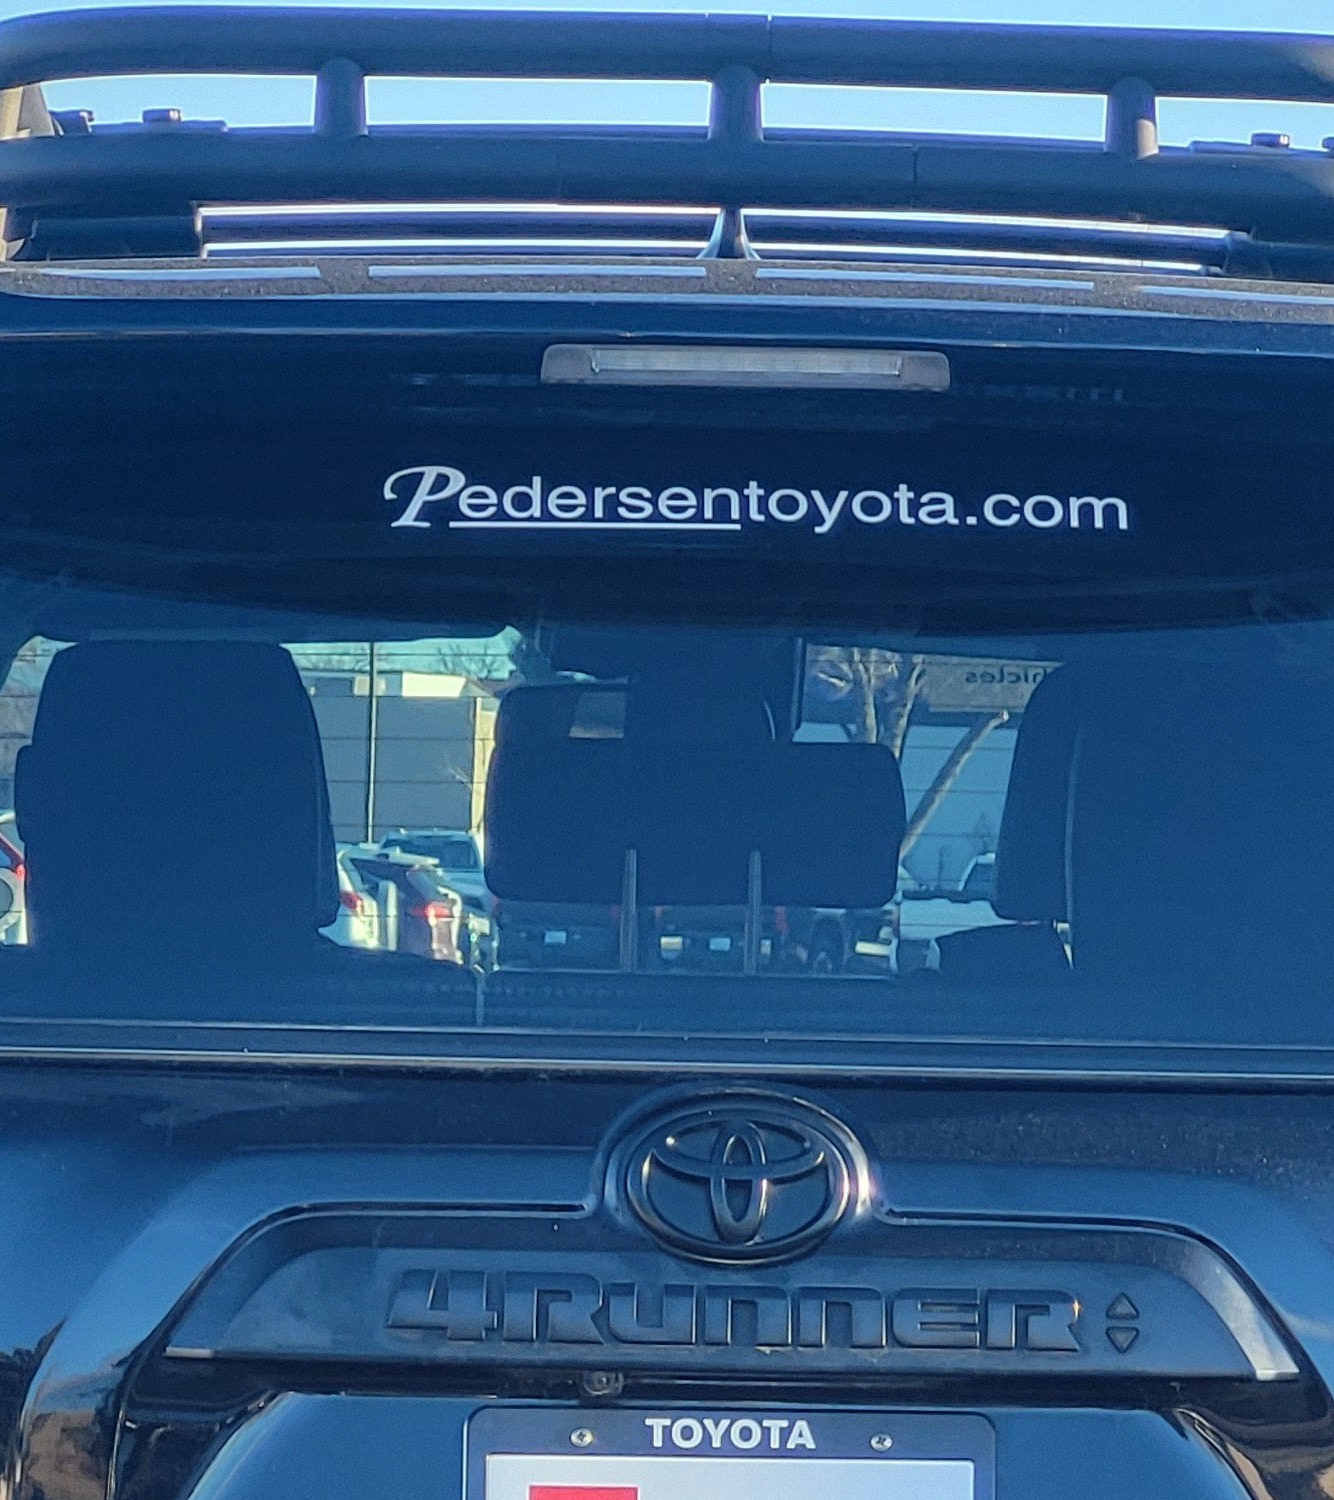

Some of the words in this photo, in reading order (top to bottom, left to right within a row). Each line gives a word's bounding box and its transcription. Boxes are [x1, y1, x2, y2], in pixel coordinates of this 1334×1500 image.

[383, 464, 1129, 534] Pedersentoyota.com
[385, 1268, 1083, 1353] 4RUNNER
[644, 1416, 817, 1451] TOYOTA
